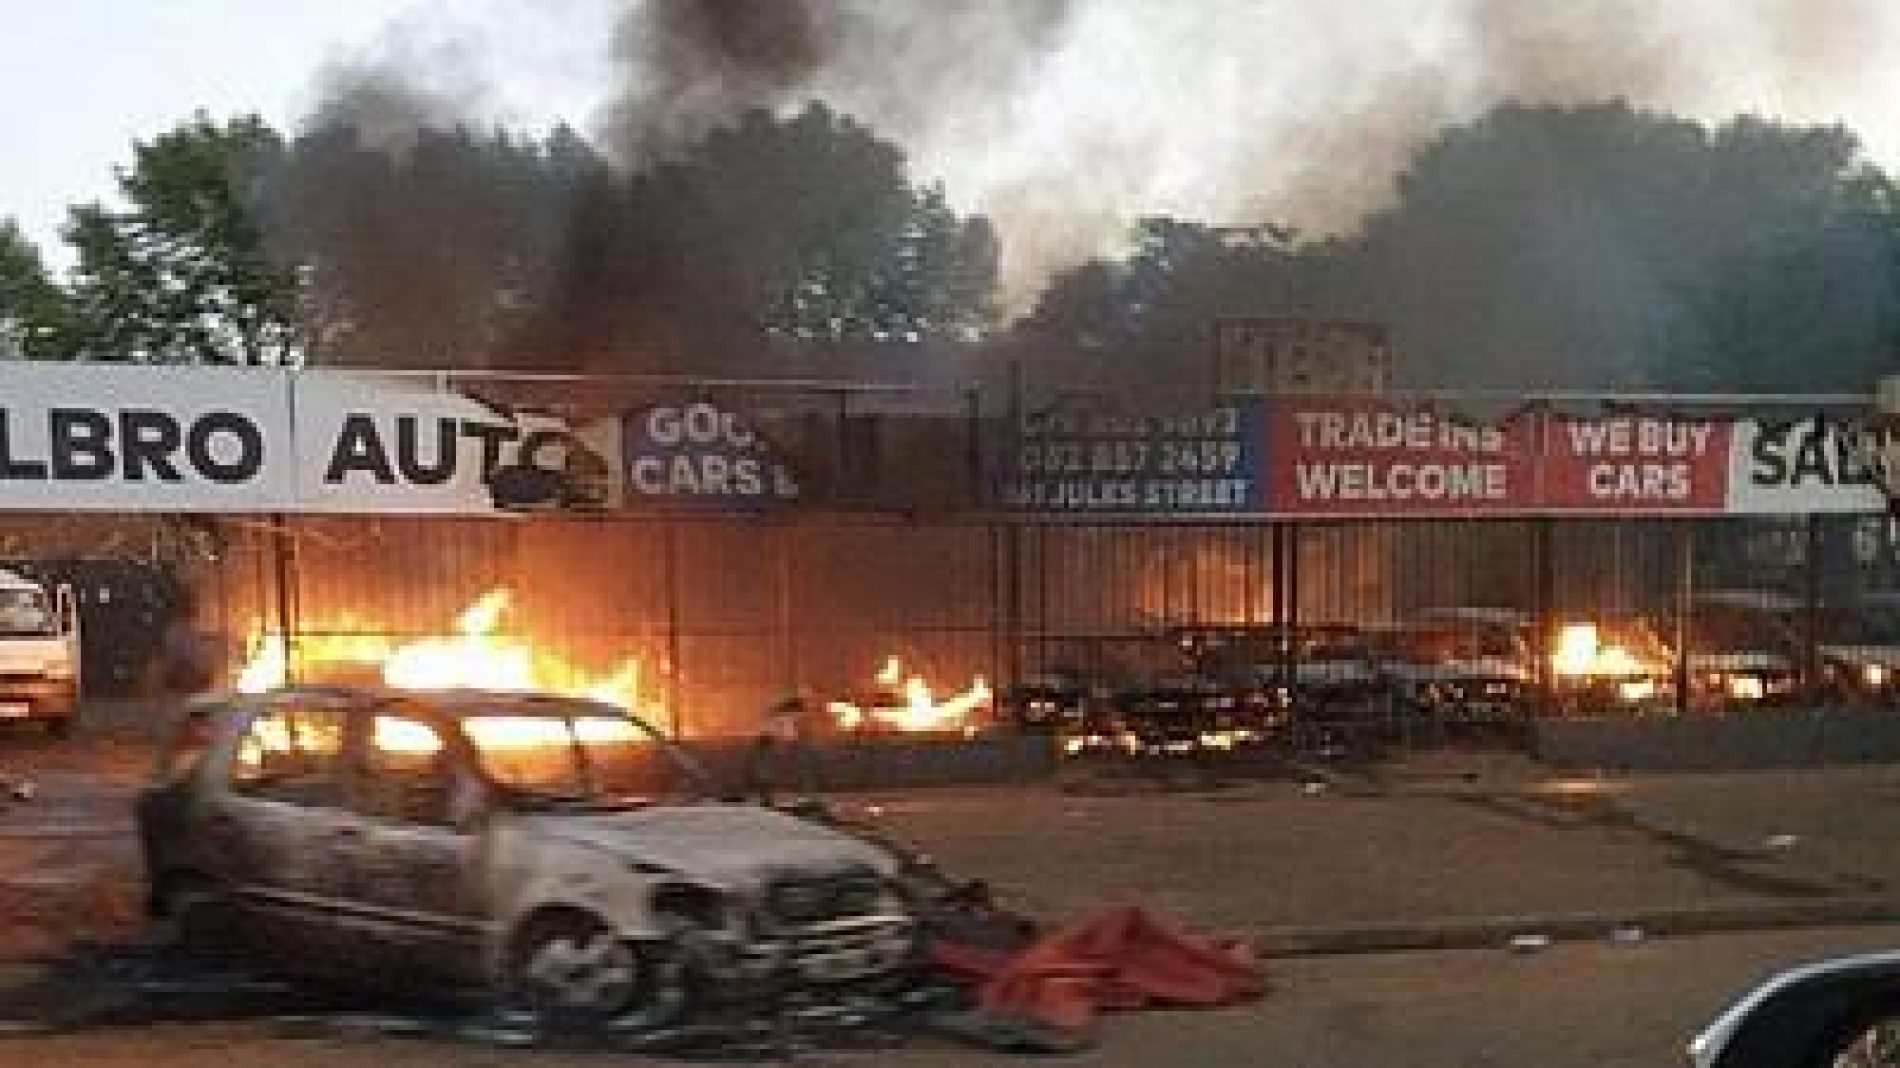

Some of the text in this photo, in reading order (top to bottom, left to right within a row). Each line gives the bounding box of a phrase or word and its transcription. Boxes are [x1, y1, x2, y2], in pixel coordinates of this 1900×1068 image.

[1295, 412, 1431, 448] TRADE
[1568, 420, 1711, 457] WE BUY
[631, 455, 761, 495] CARS
[1144, 479, 1248, 506] STREET
[1296, 463, 1506, 500] WELCOME
[1588, 464, 1692, 500] CARS
